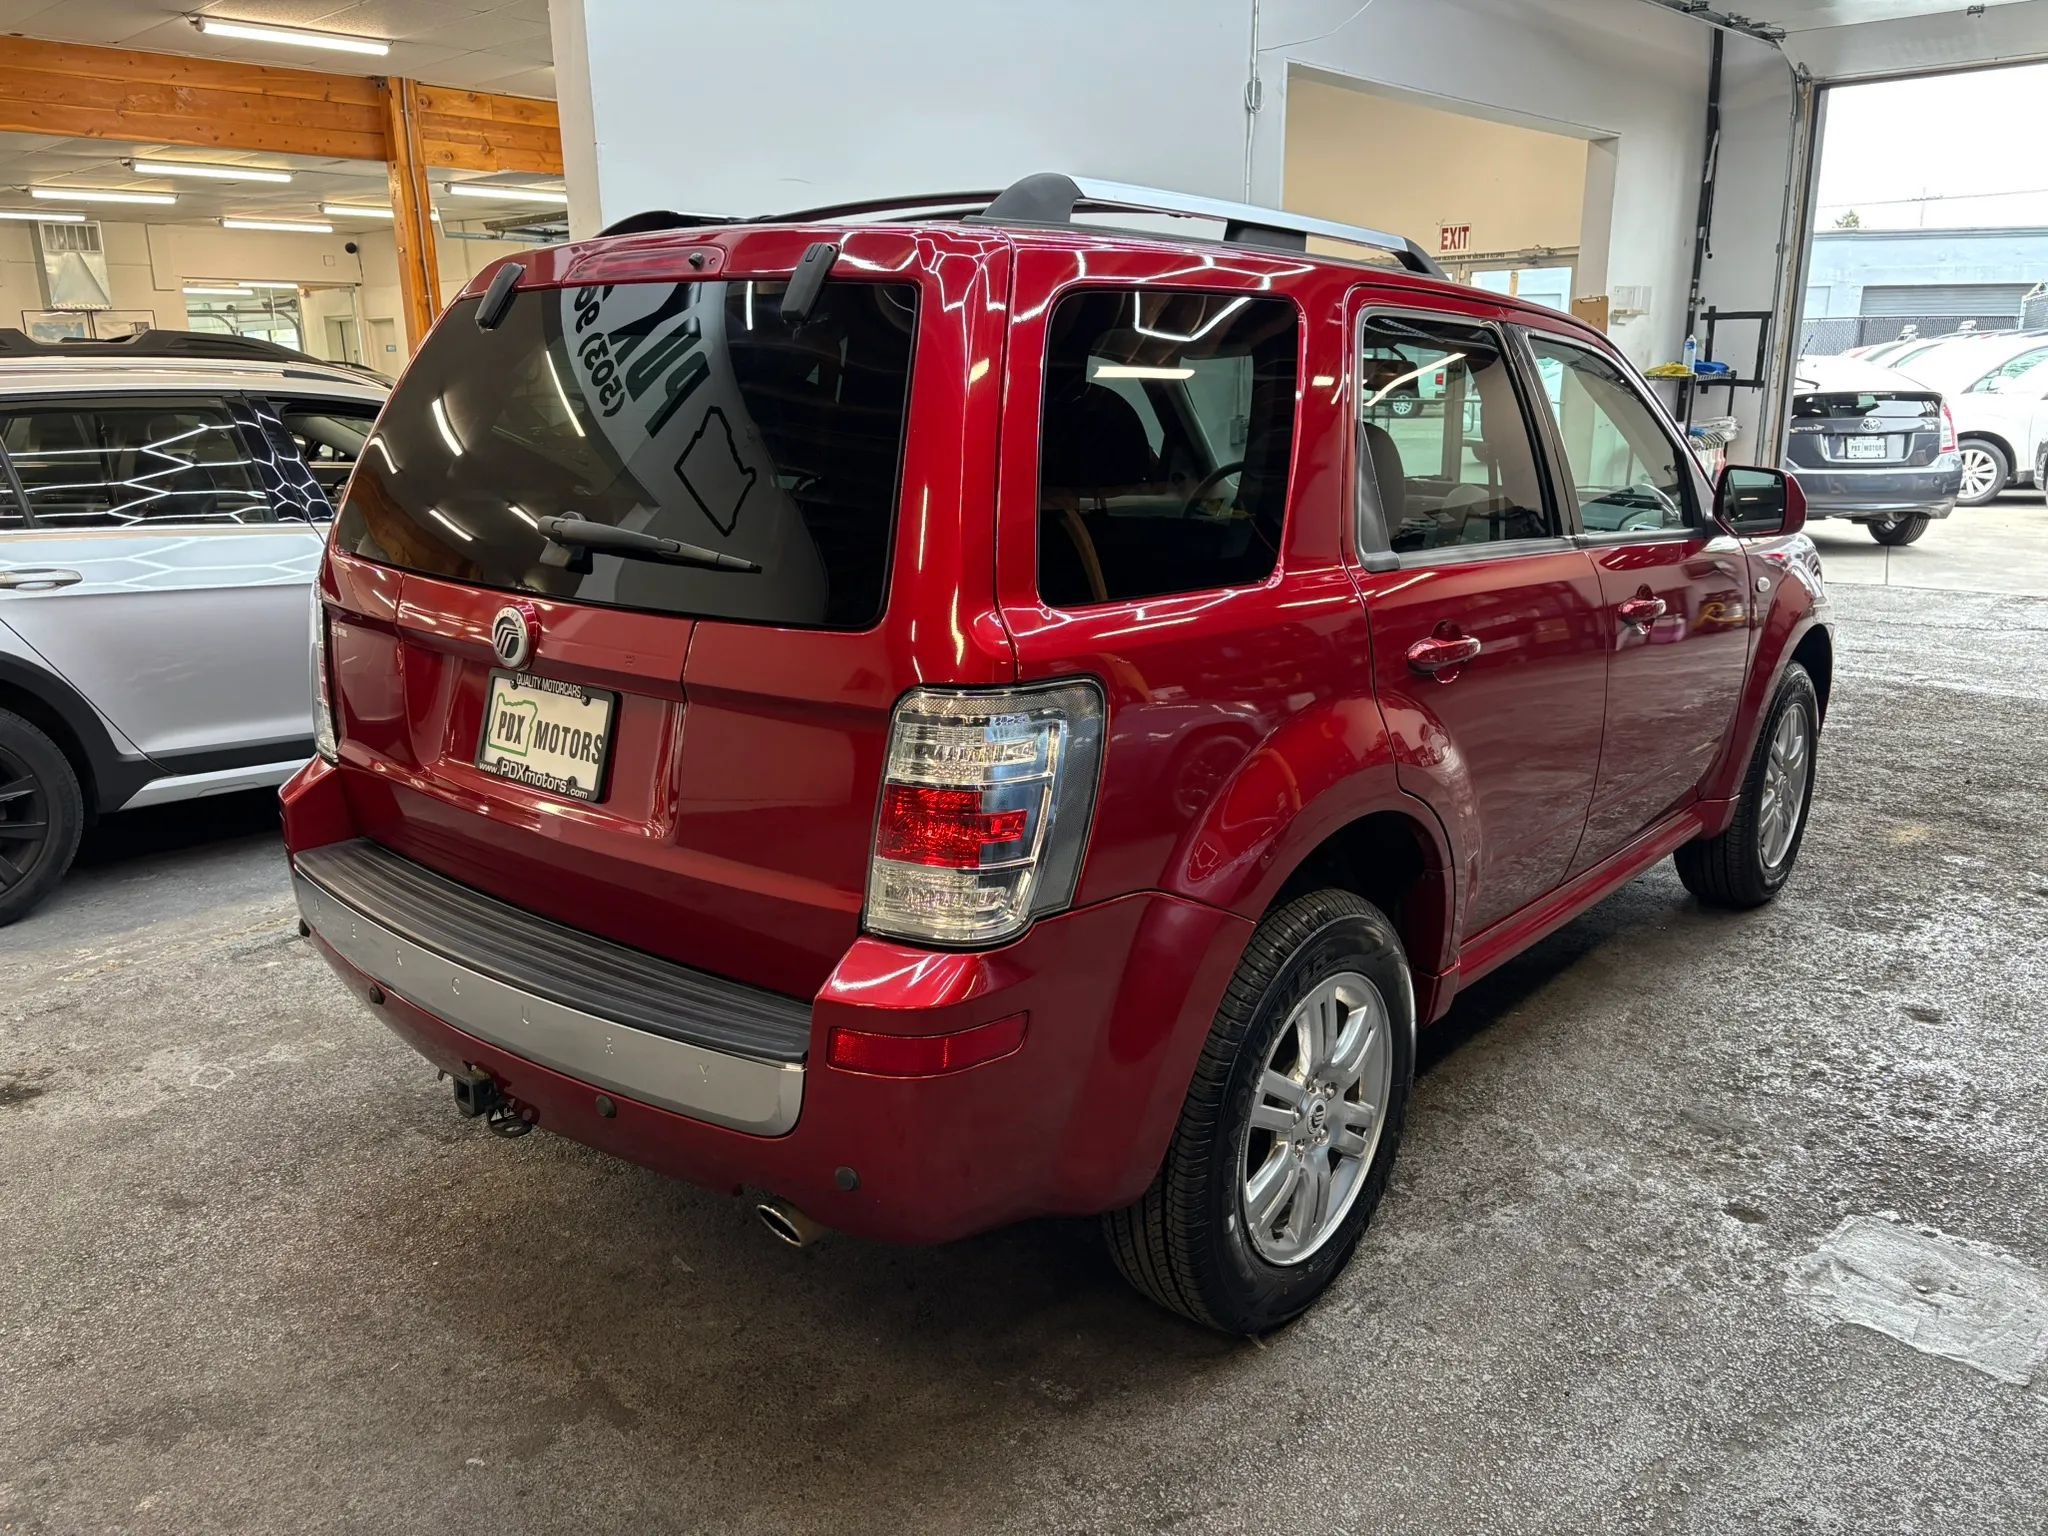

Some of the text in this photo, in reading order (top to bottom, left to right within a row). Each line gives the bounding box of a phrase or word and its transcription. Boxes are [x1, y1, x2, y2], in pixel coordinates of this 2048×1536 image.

[1441, 226, 1469, 250] EXIT
[516, 673, 582, 699] QUALITY MOTORCARS
[497, 710, 604, 765] PDX MOTORS
[479, 759, 588, 800] www.PDXmotors.com
